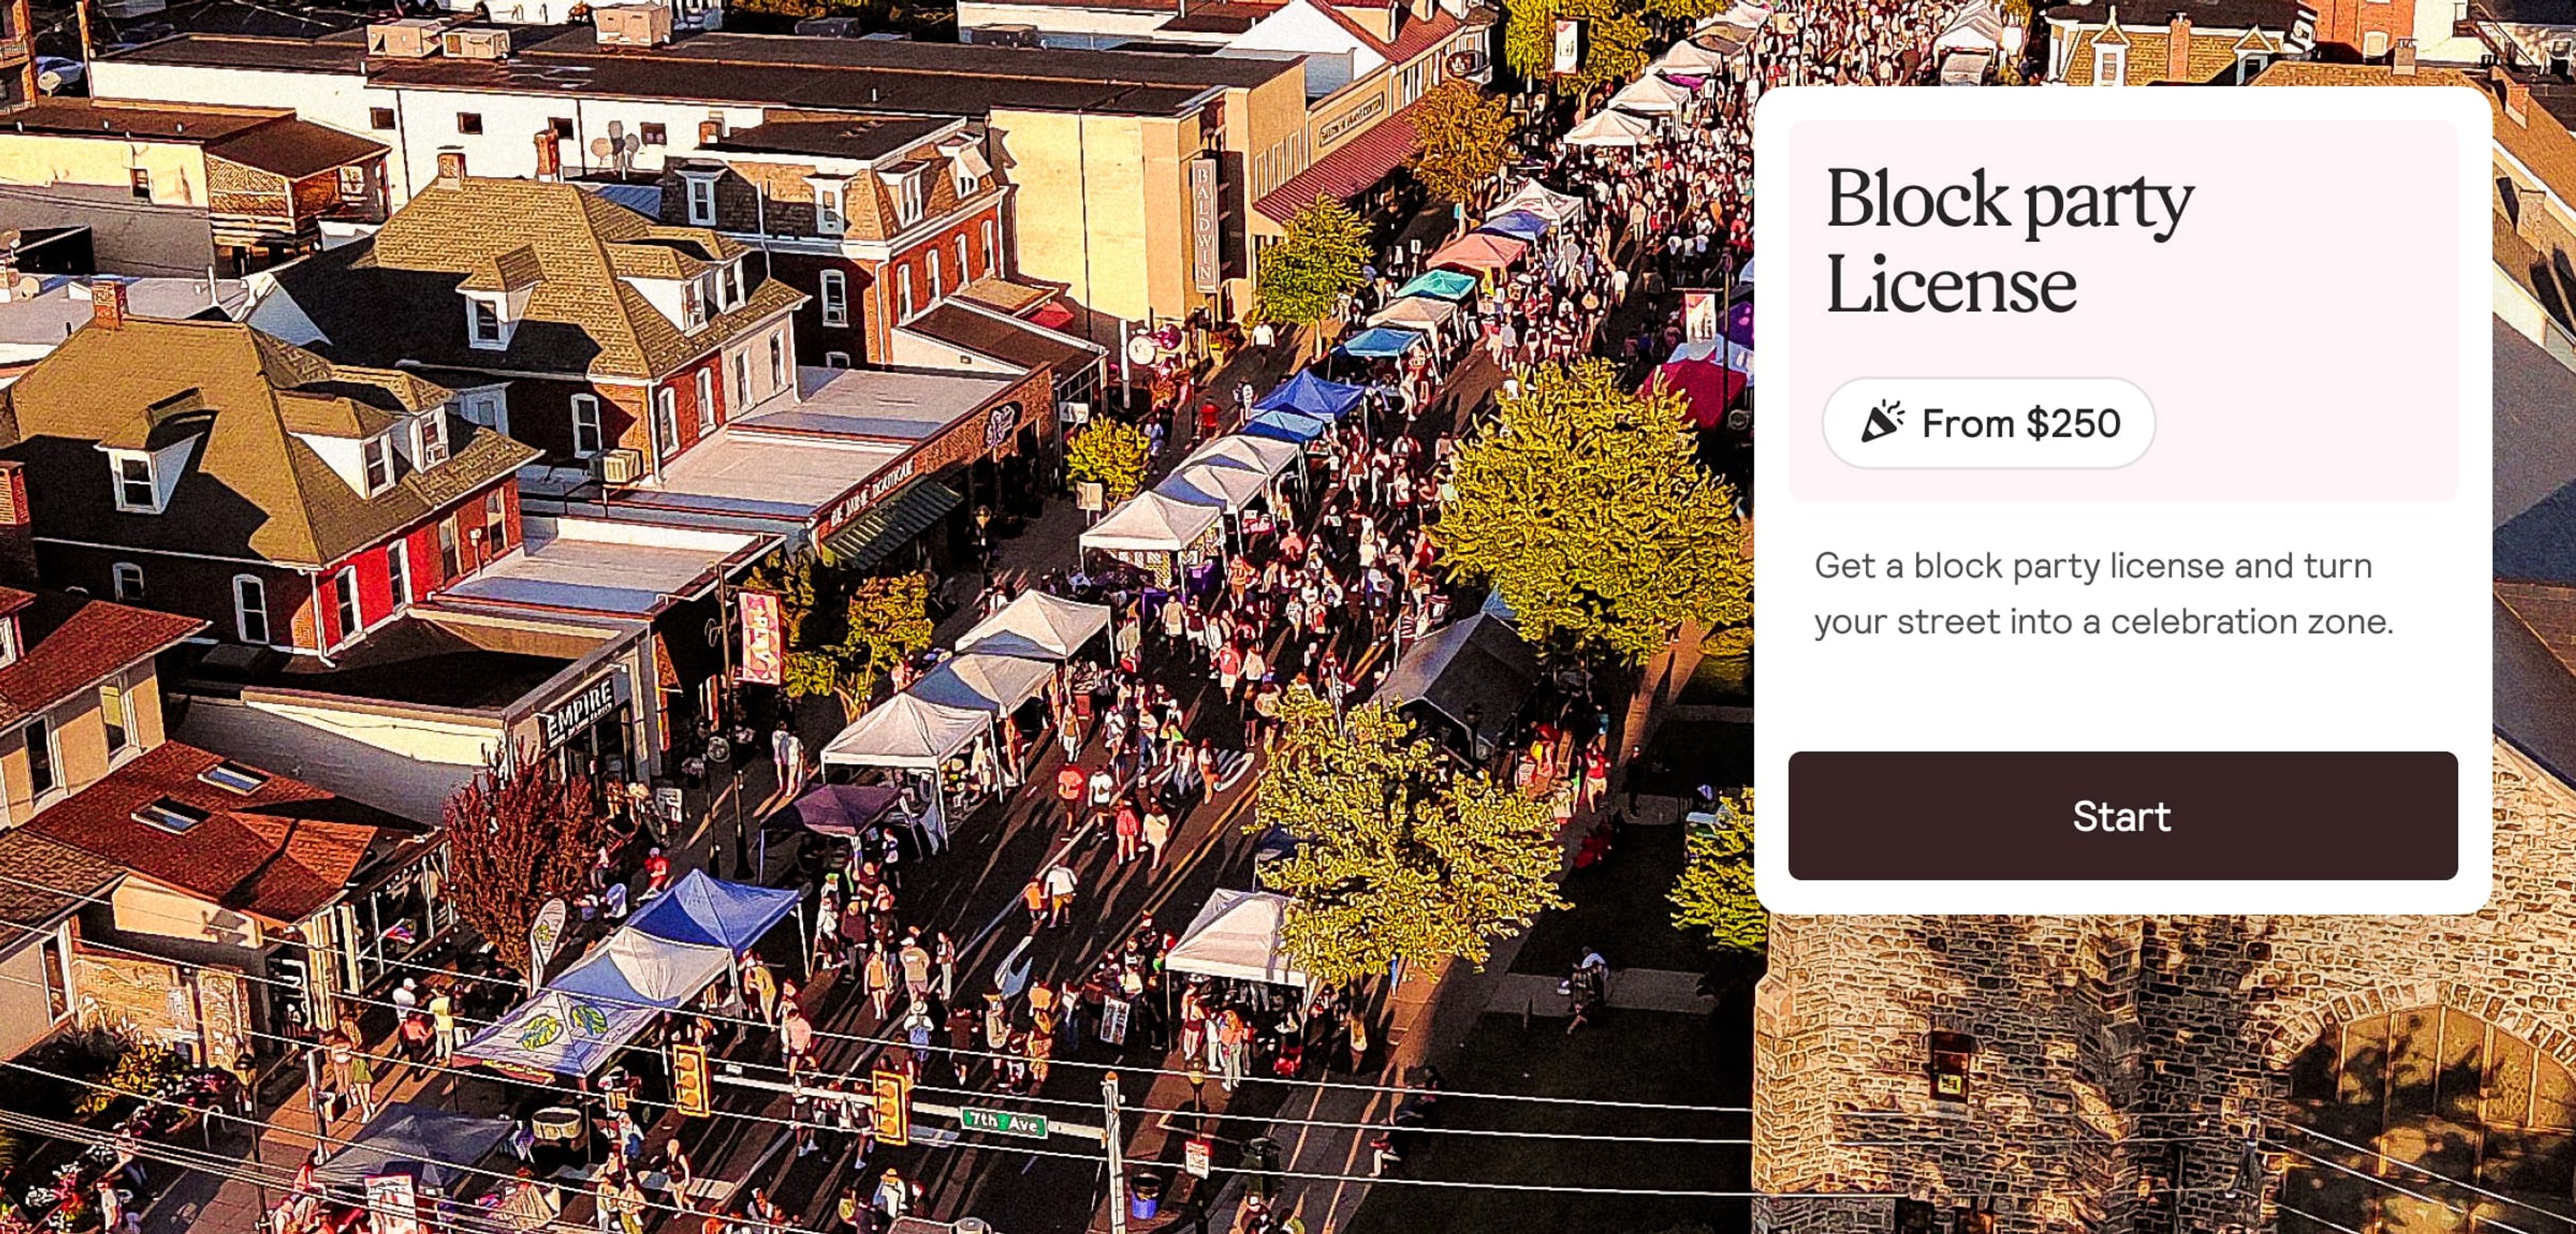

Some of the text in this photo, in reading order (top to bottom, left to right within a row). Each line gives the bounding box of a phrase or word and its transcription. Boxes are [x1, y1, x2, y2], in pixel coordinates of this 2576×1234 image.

[1197, 168, 1212, 280] BALDWIN
[872, 457, 913, 498] BOUTIQUE
[547, 679, 612, 740] EMPIRE
[970, 1111, 1038, 1132] 7th Ave
